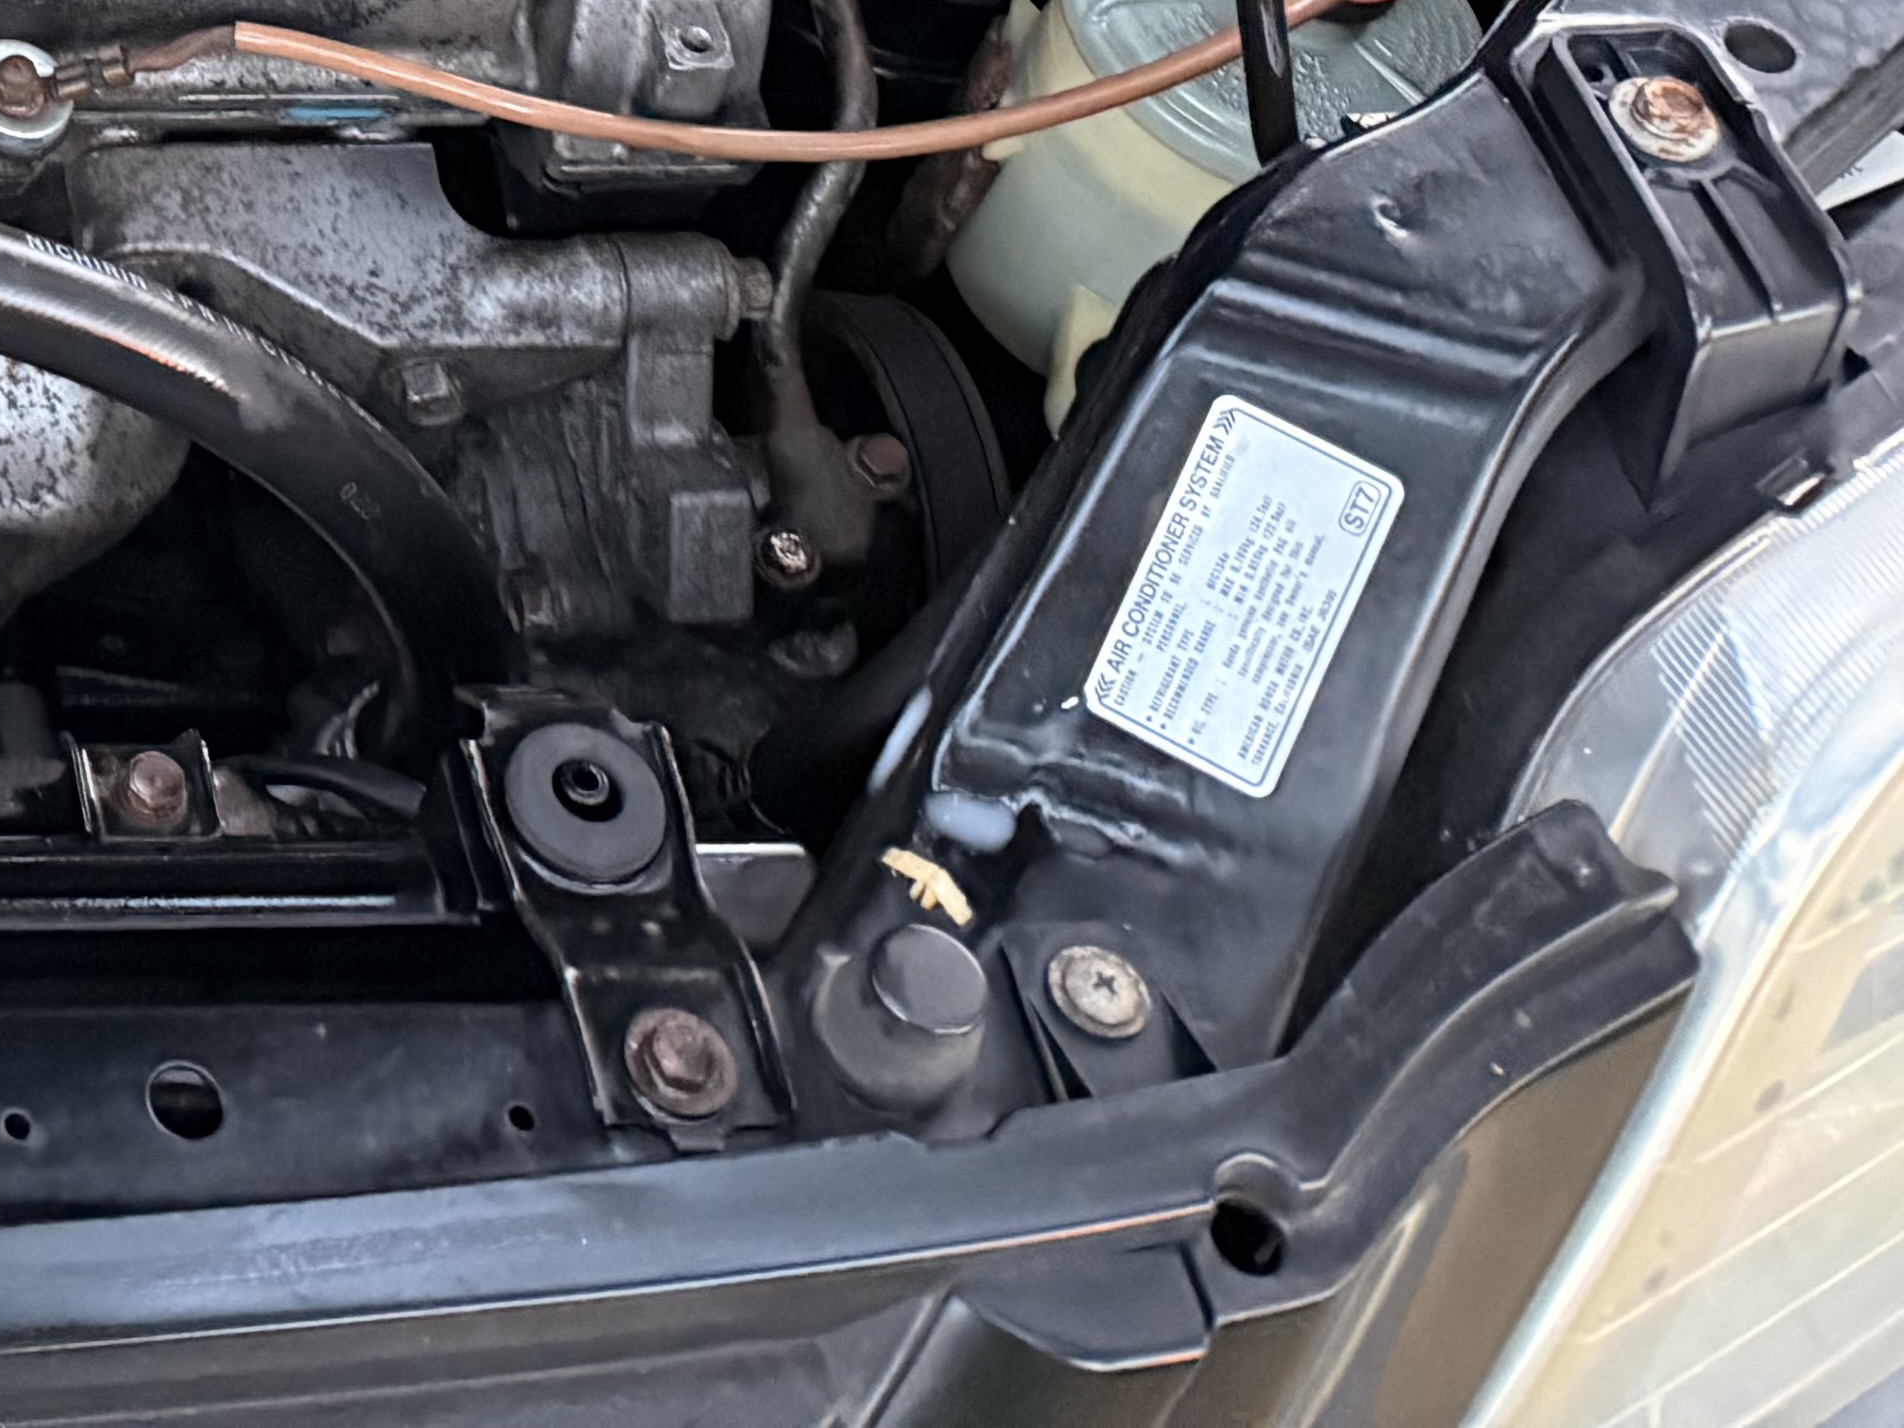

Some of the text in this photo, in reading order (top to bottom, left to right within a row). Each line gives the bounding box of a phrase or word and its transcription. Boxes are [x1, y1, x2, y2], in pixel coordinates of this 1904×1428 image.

[1106, 434, 1224, 674] AIR CONDITIONER SYSTEM
[1340, 485, 1374, 530] ST7
